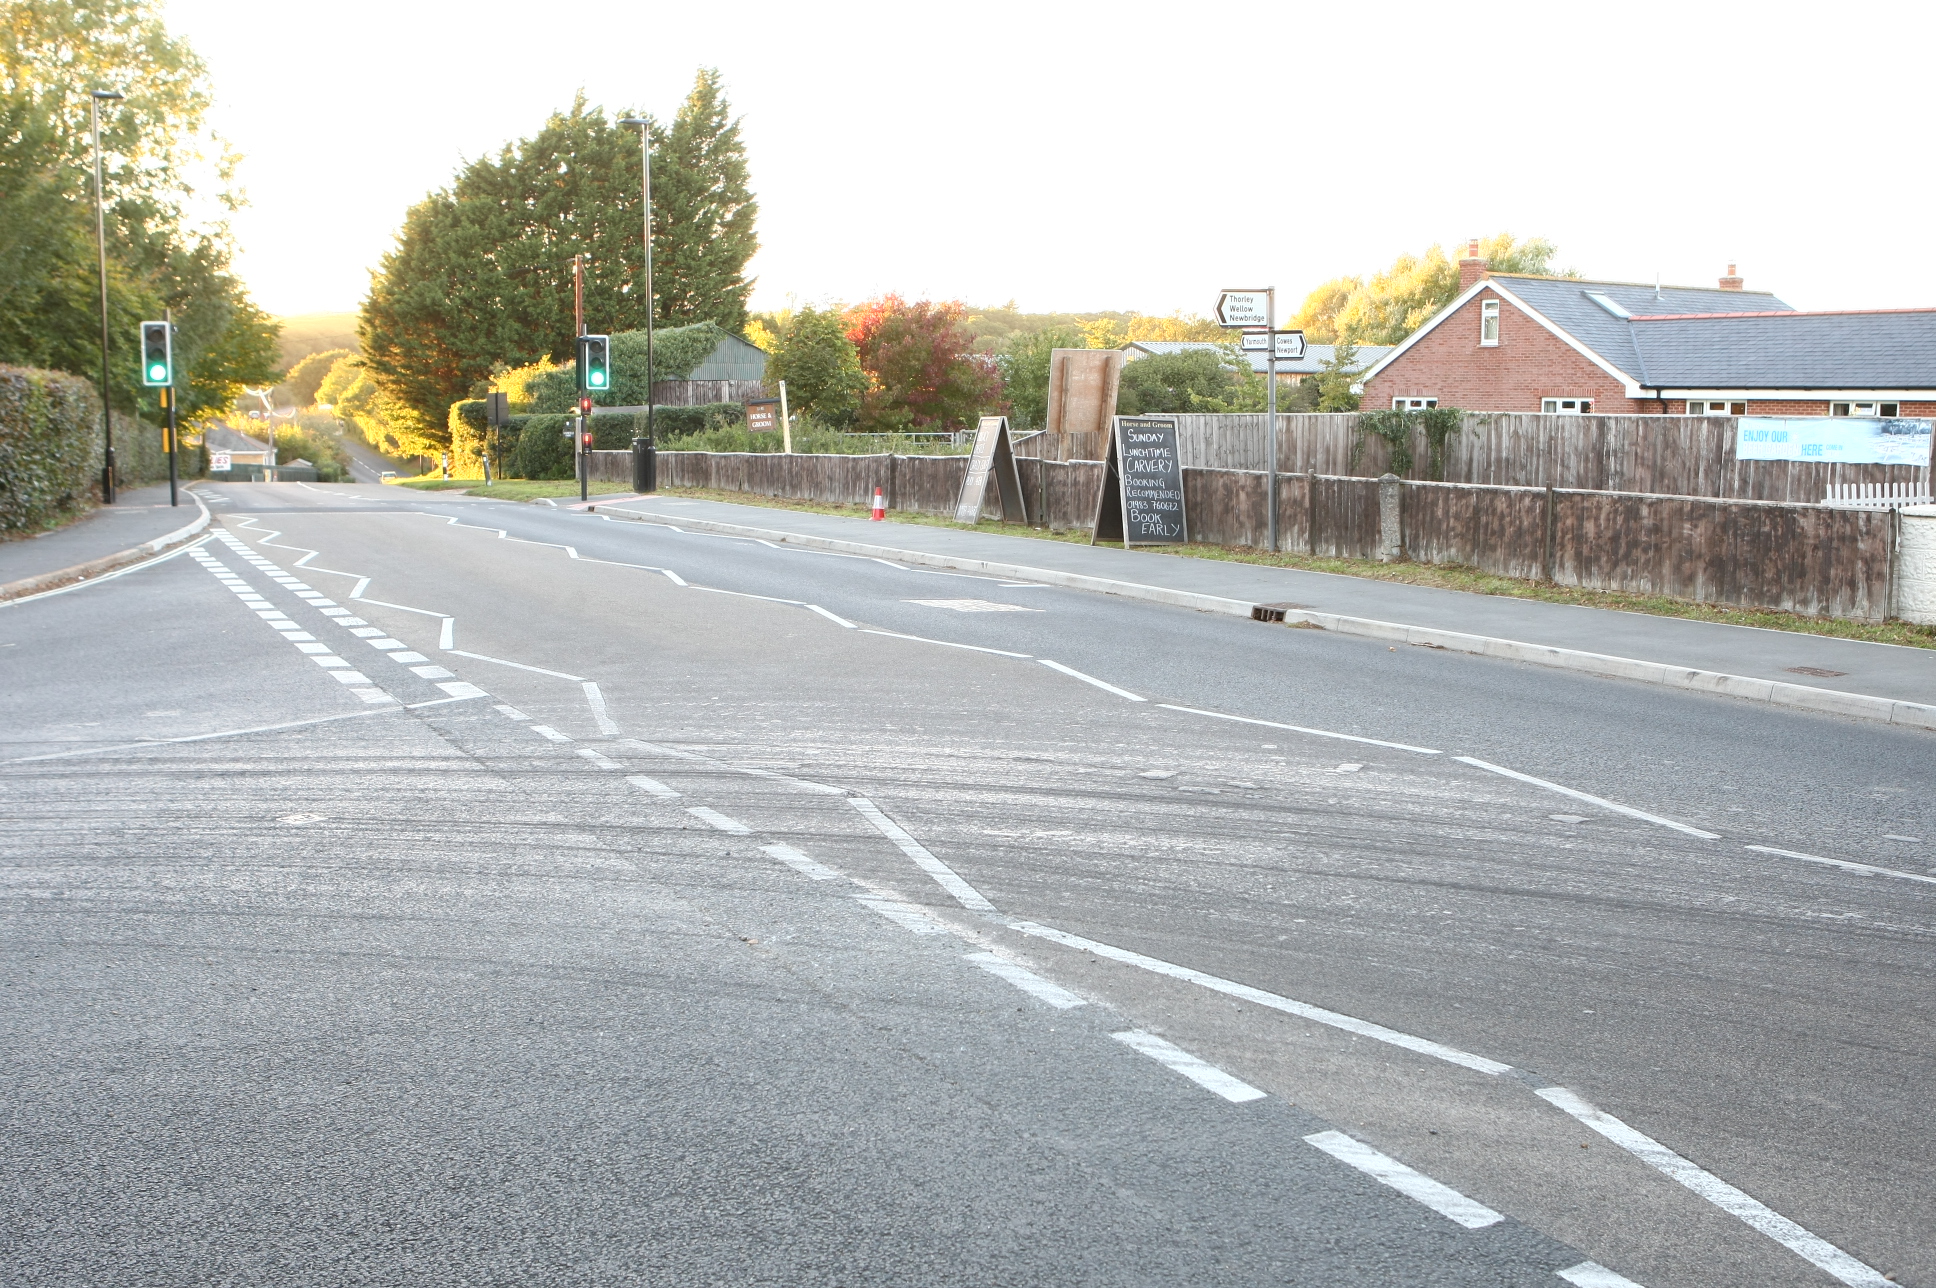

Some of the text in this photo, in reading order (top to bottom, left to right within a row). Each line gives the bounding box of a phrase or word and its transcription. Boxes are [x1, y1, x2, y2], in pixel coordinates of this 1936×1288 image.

[1230, 296, 1253, 304] Thorley
[1127, 428, 1165, 443] SUNDAY
[1743, 429, 1788, 443] ENJOY OUR
[1122, 443, 1172, 458] LUNCHTIME
[1801, 443, 1823, 456] HERE
[1126, 457, 1173, 473] CARVERY
[1125, 474, 1165, 489] BOOKING
[1126, 486, 1181, 500] RECOMMENDED
[1127, 500, 1149, 510] 01983
[1130, 509, 1163, 524] BOOK
[1141, 522, 1180, 537] EARLY
